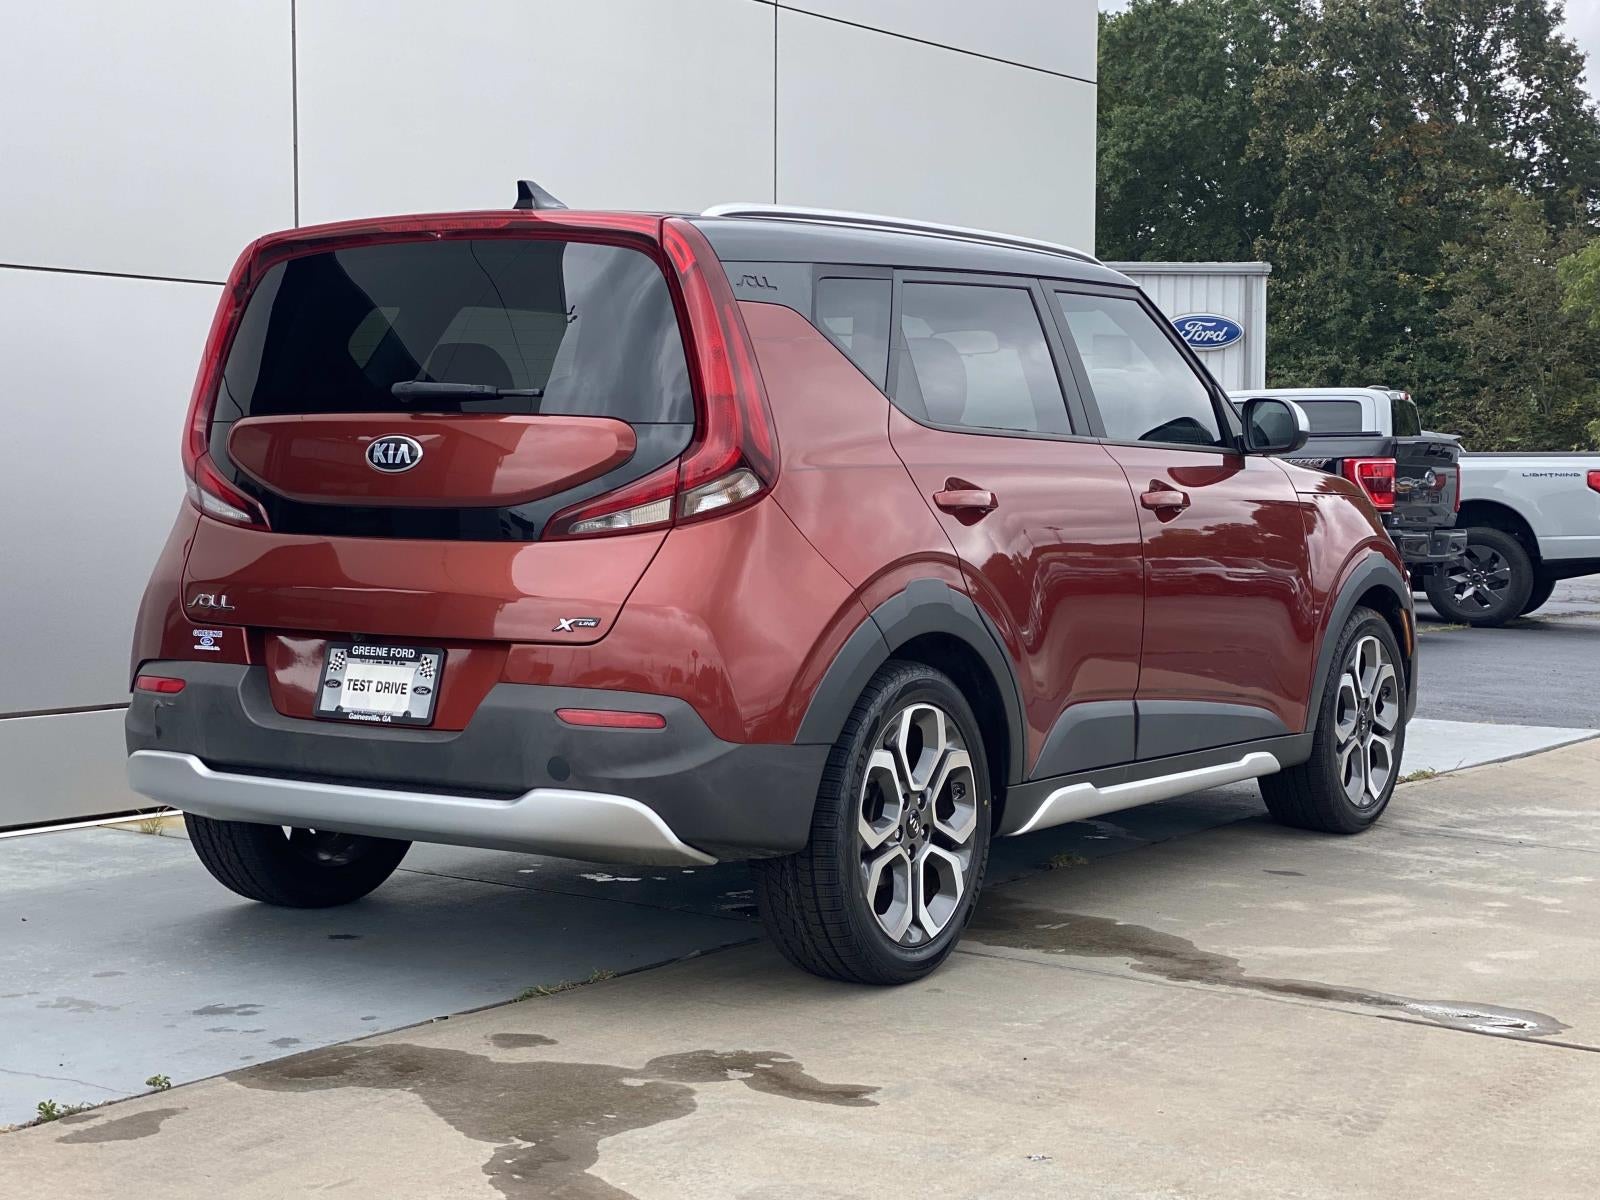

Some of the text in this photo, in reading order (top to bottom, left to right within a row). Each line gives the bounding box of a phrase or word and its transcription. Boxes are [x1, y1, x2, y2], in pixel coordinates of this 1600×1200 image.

[1180, 320, 1228, 342] Ford
[373, 443, 411, 463] KIA
[187, 593, 236, 610] SOUL
[352, 645, 416, 658] GREENE FORD
[346, 679, 408, 695] TEST DRIVE
